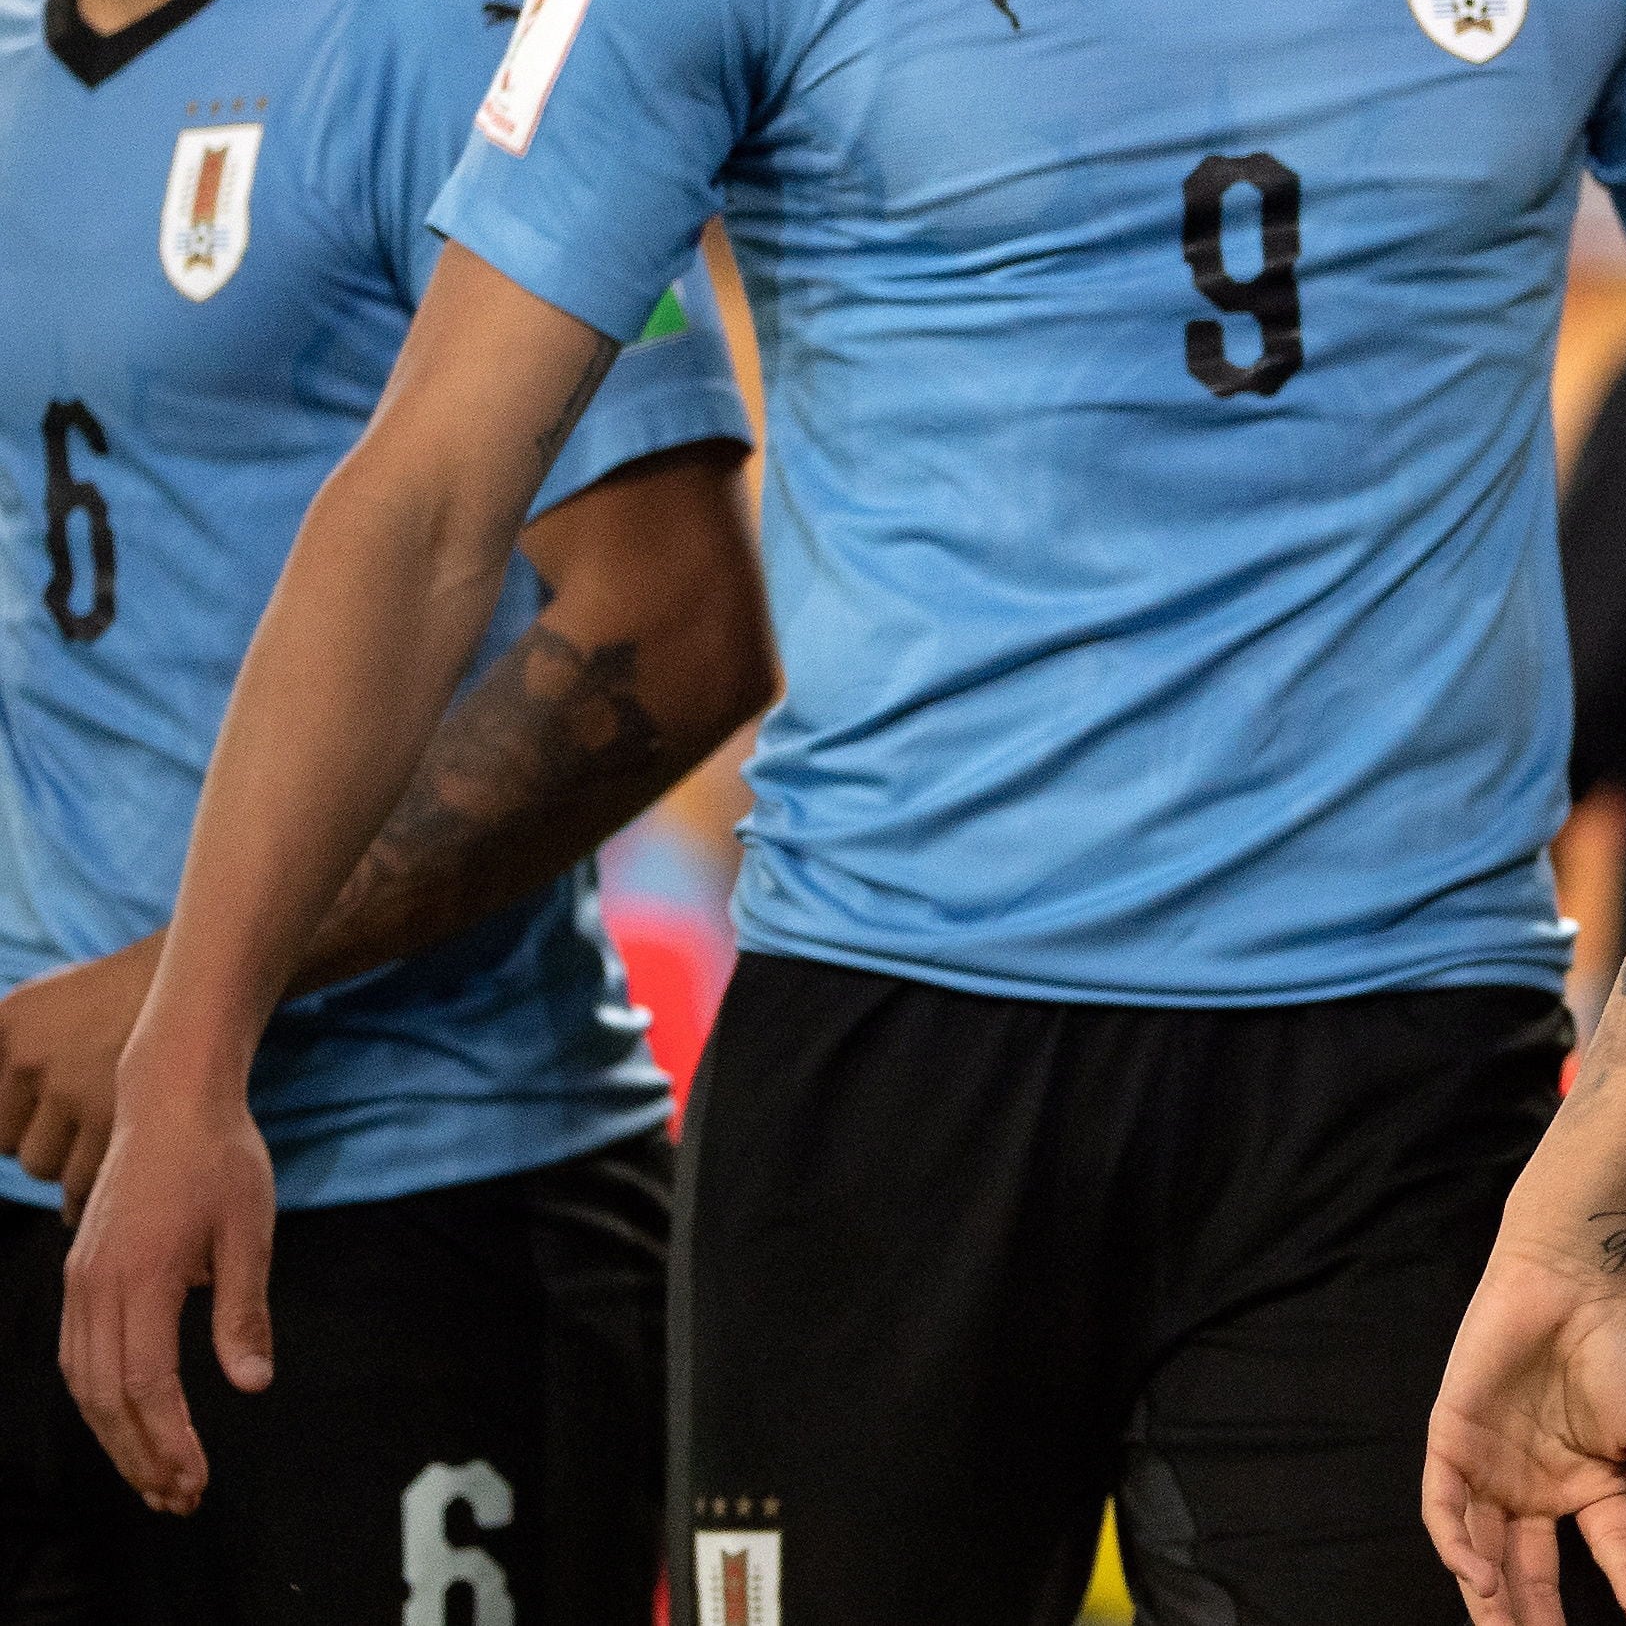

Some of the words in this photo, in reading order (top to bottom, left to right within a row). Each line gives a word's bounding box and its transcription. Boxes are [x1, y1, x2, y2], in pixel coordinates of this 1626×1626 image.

[1182, 151, 1304, 398] 9
[43, 397, 117, 641] 6
[401, 1459, 516, 1626] 6
